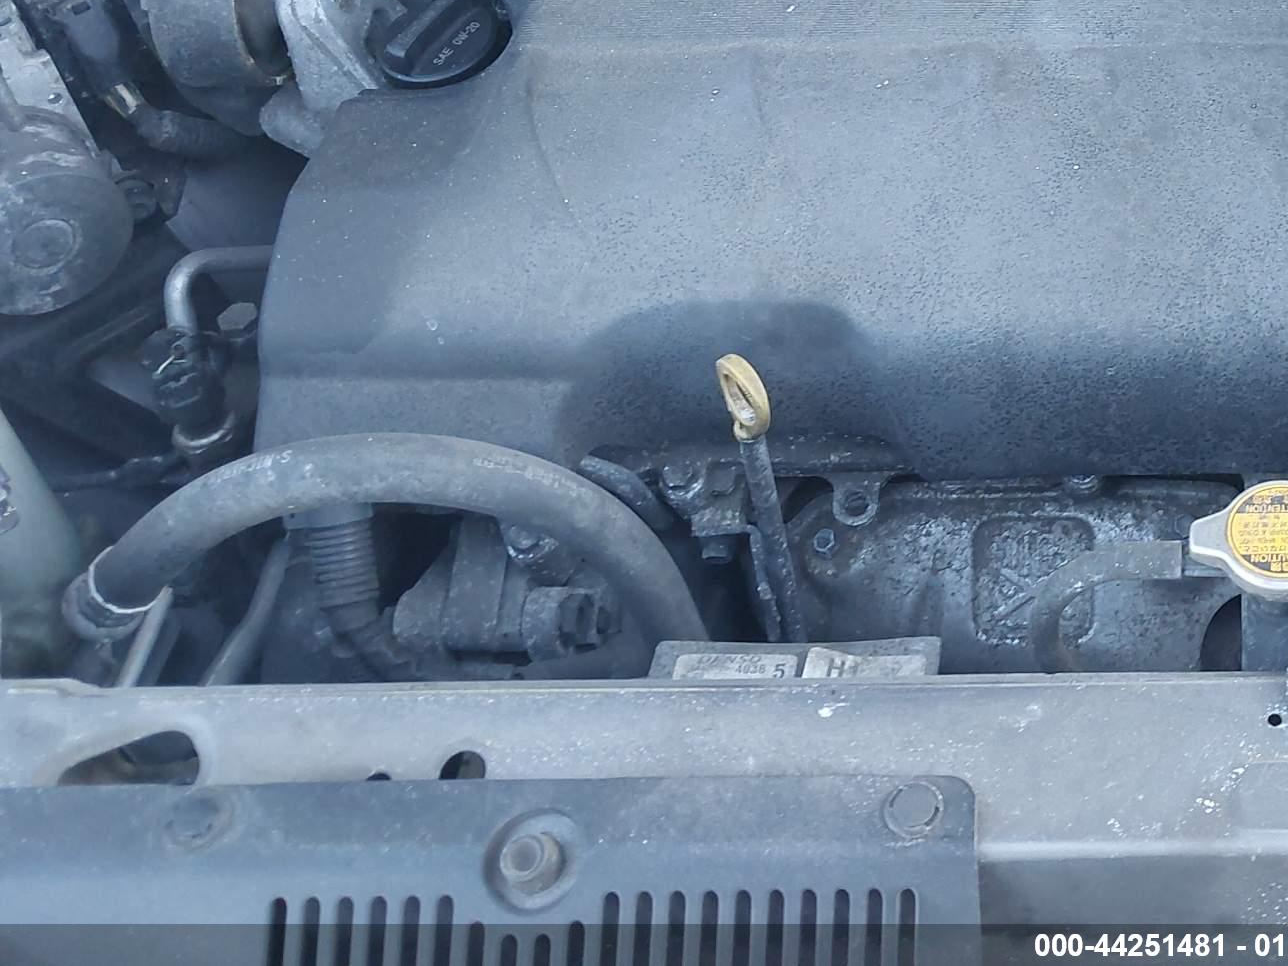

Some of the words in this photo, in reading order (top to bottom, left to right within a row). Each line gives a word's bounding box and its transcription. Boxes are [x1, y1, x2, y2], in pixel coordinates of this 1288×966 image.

[433, 46, 454, 66] SAE
[452, 21, 481, 46] 0W-20
[772, 663, 786, 679] 5
